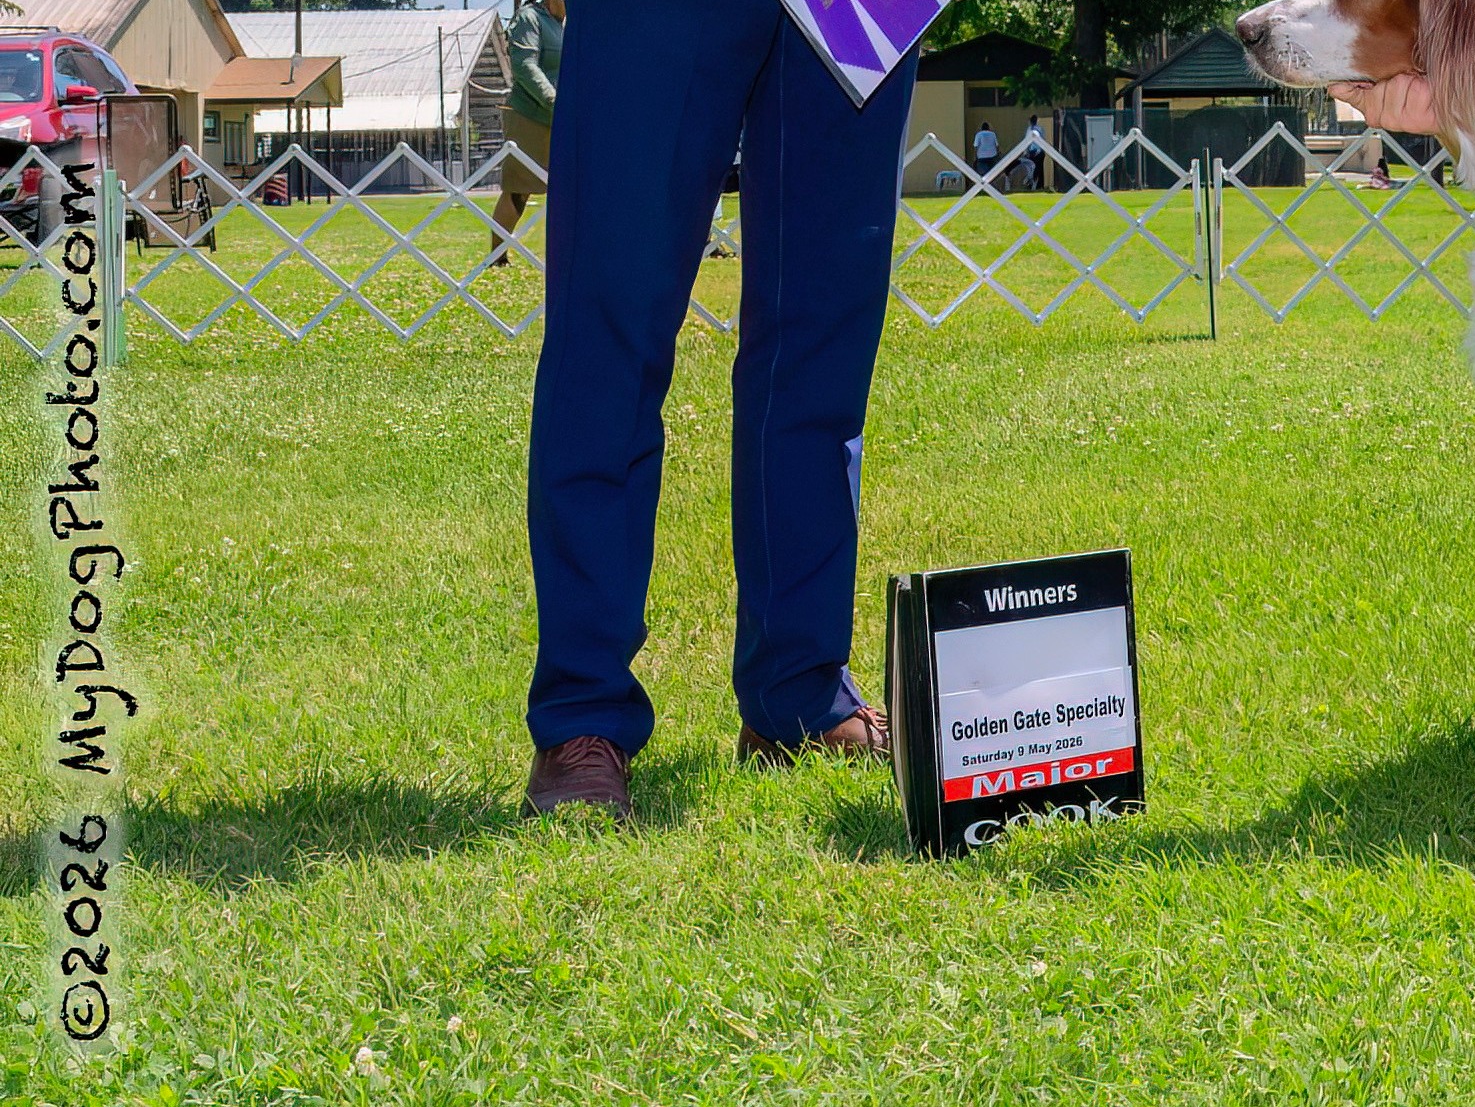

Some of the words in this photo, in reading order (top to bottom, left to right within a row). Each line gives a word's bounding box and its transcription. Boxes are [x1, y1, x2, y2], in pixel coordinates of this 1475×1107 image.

[984, 583, 1078, 612] Winners
[952, 716, 1008, 741] Golden
[1014, 708, 1051, 731] Gate
[1056, 695, 1126, 727] Specialty
[962, 748, 1014, 767] Saturday
[1018, 745, 1025, 756] 9
[1028, 742, 1052, 754] May
[1055, 735, 1083, 750] 2026
[971, 756, 1114, 799] Major
